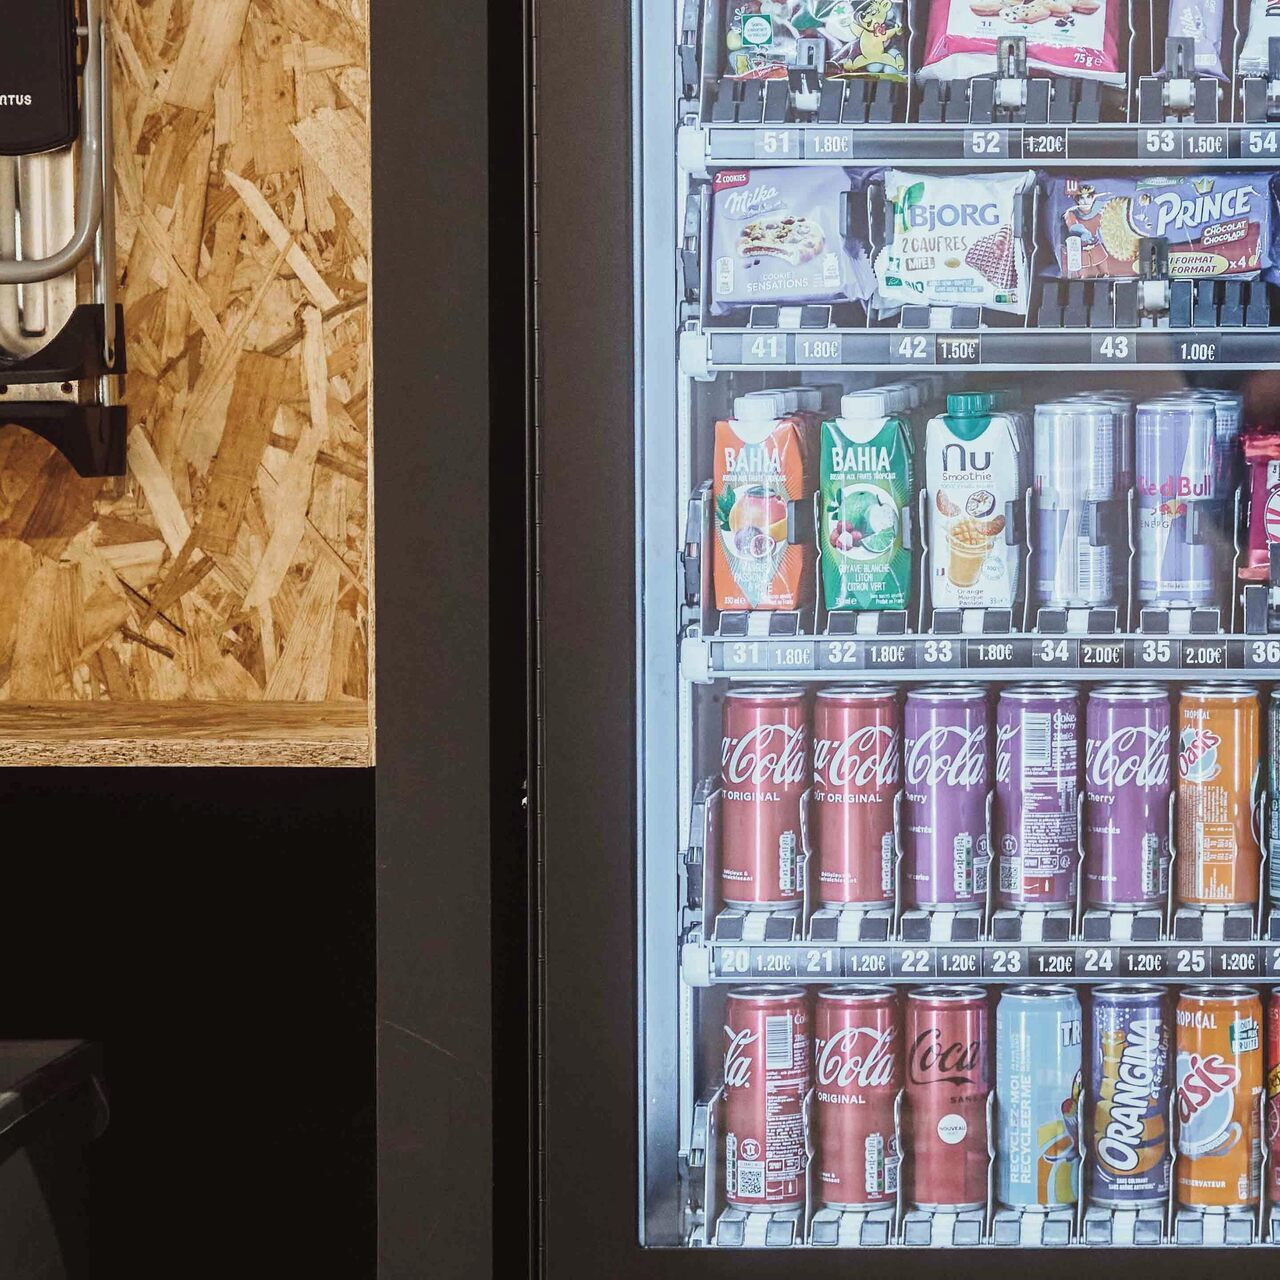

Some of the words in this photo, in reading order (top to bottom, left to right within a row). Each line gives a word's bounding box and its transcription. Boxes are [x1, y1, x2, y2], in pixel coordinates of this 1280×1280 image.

[763, 131, 790, 153] 51
[813, 135, 849, 153] 1.80€
[971, 131, 1001, 153] 52
[1028, 136, 1064, 154] 1.20€
[1146, 131, 1175, 152] 53
[1187, 136, 1222, 154] 1.50€
[1248, 131, 1278, 152] 54
[715, 173, 721, 182] 2
[722, 174, 747, 183] COOKIES
[1154, 185, 1254, 236] PRINCE
[1203, 220, 1247, 236] CHOCOLAT
[1203, 229, 1246, 245] CHOCOLADE
[902, 242, 908, 253] 2
[908, 257, 933, 270] MIEL
[1171, 265, 1217, 274] FORMAAT
[1175, 255, 1214, 264] FORMAT
[746, 278, 809, 292] SENSATIONS
[751, 337, 778, 358] 41
[802, 341, 838, 359] 1.80€
[899, 336, 927, 358] 42
[941, 342, 976, 359] 1.50€
[1099, 336, 1129, 358] 43
[1180, 343, 1216, 361] 1.00€
[724, 447, 781, 473] BAHIA
[832, 447, 891, 472] BAHIA
[942, 472, 992, 482] Smoothie
[1139, 475, 1172, 497] Red
[1177, 475, 1213, 498] Bull
[828, 641, 857, 663] 32
[870, 646, 905, 663] 1.80€
[1040, 640, 1069, 662] 34
[1083, 646, 1120, 664] 2.00€
[1251, 641, 1280, 663] 36
[727, 791, 781, 802] ORIGINAL
[827, 792, 883, 803] ORIGINAL
[806, 950, 832, 971] 21
[851, 955, 886, 972] 1.20€
[1084, 950, 1113, 971] 24
[1127, 954, 1162, 971] 1.20€
[817, 1094, 866, 1105] ORIGINAL
[1097, 1018, 1162, 1172] ORANGINA
[1010, 1074, 1020, 1184] RECYCLEZ-MOI
